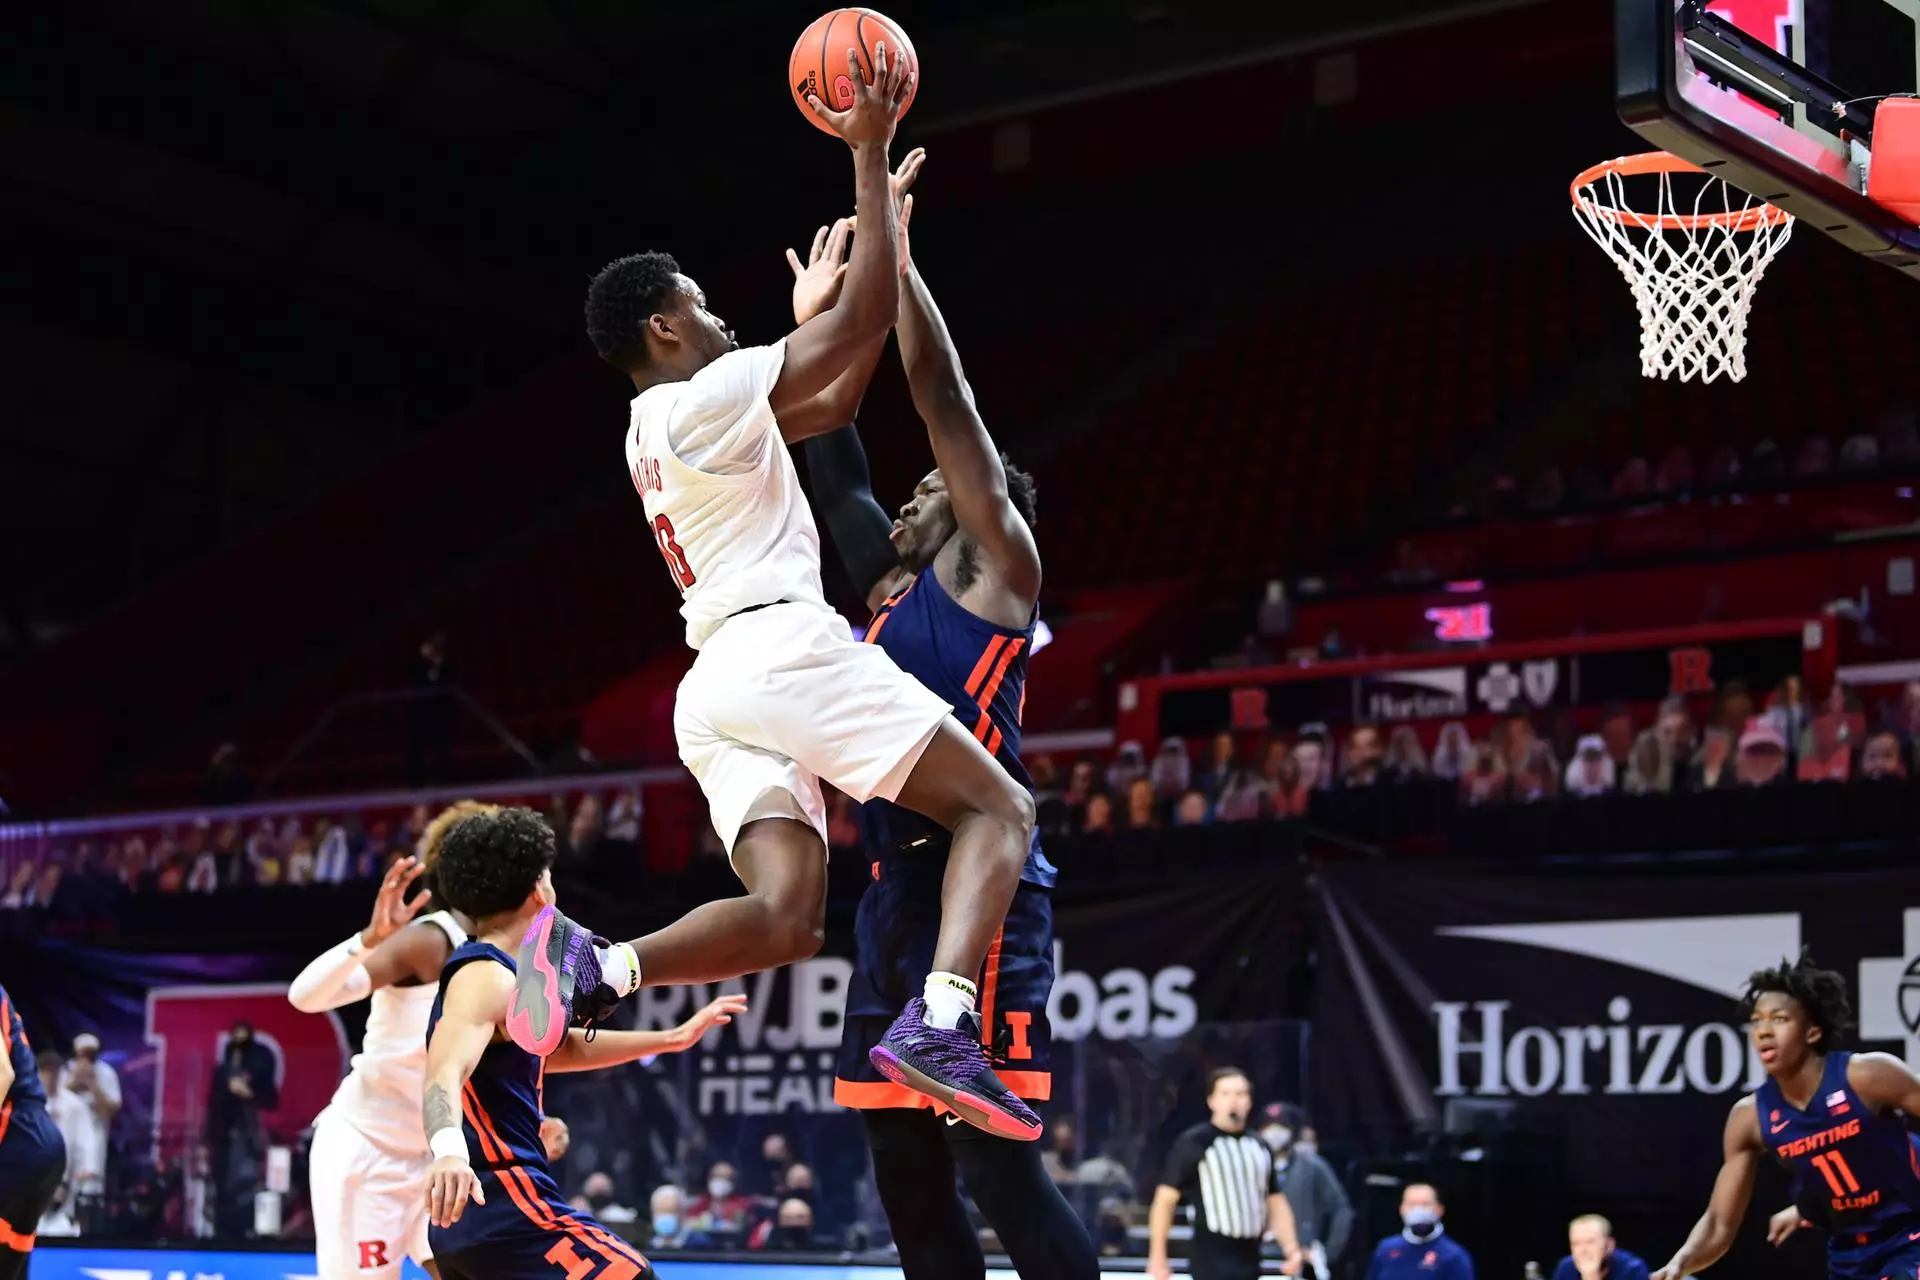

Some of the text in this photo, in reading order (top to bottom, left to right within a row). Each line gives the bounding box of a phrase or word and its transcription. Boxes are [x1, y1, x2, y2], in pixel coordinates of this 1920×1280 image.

[700, 1053, 846, 1115] HEAL
[1776, 1118, 1861, 1159] FIGHTING
[1810, 1149, 1861, 1198] 11
[358, 1240, 389, 1269] R
